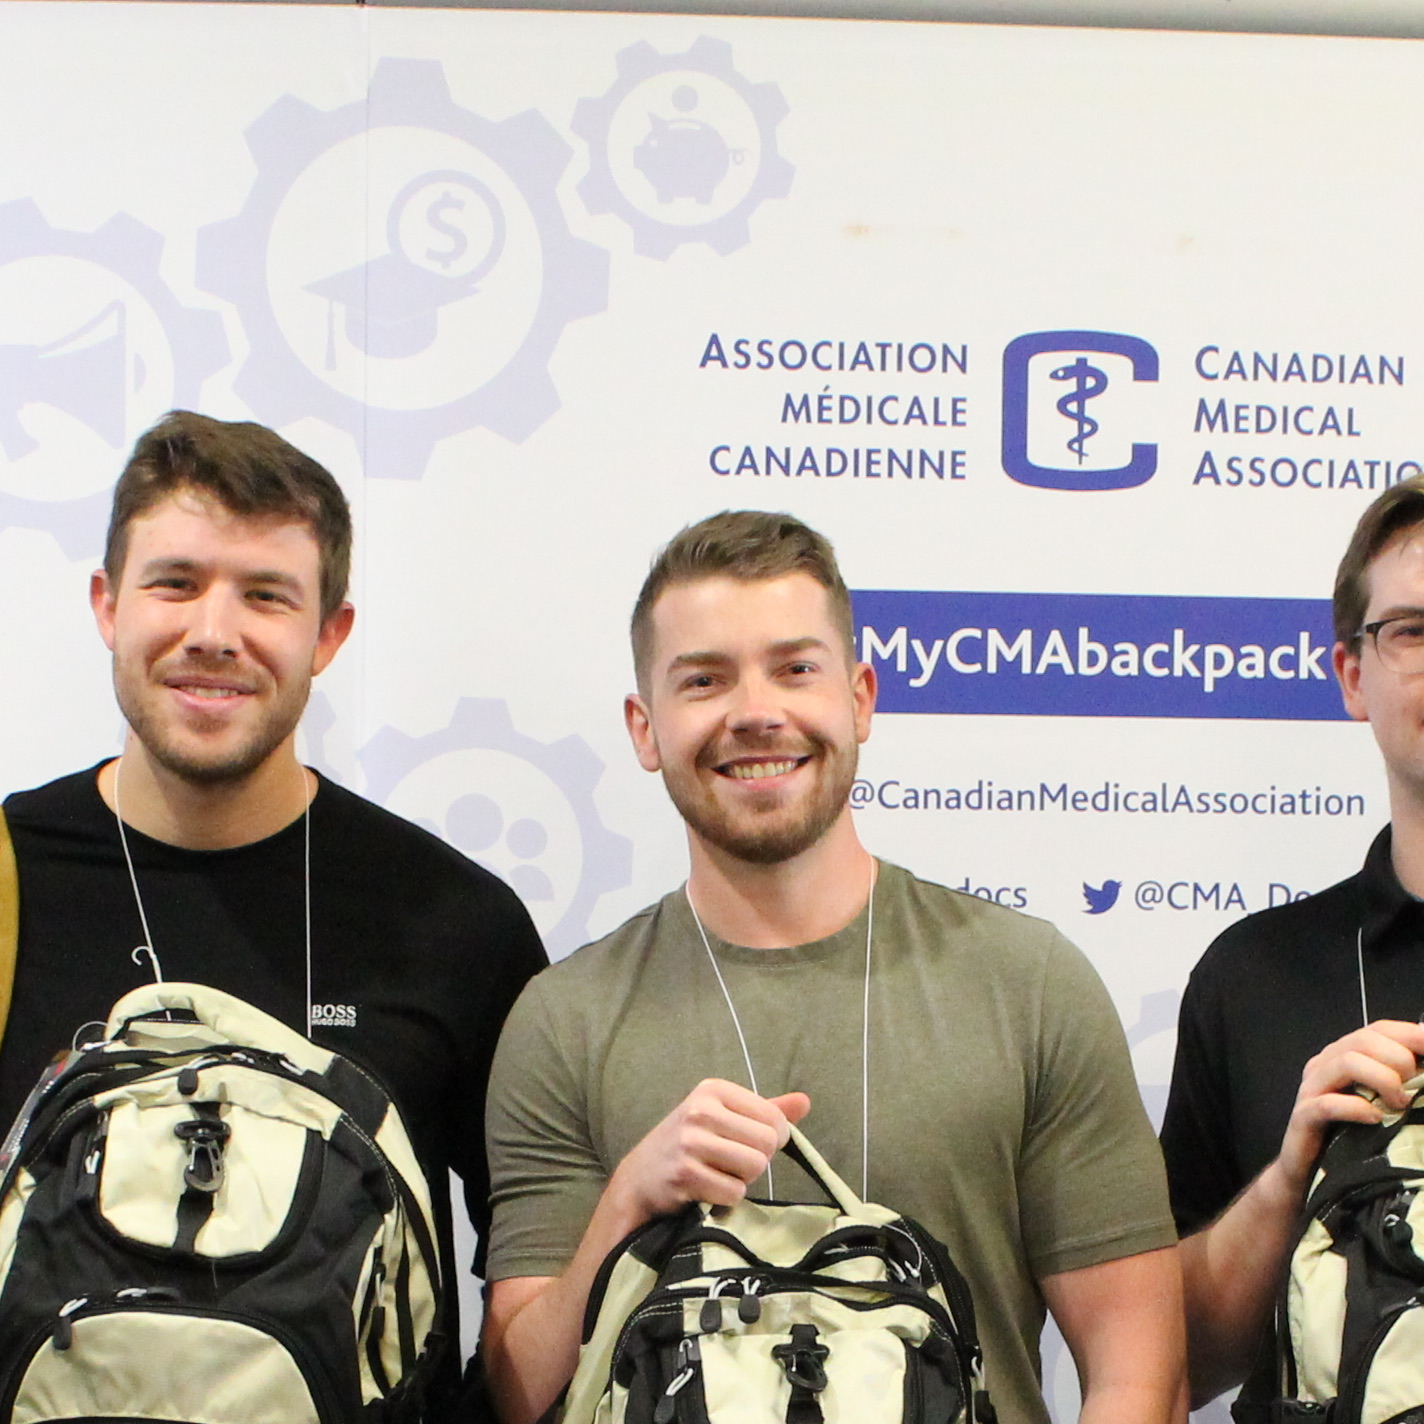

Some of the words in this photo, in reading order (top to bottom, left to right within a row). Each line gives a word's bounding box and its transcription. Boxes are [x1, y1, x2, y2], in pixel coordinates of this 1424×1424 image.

[700, 334, 967, 373] ASSOCIATION
[1196, 345, 1403, 384] CANADIAN
[782, 387, 966, 425] MÉDICALE
[1195, 398, 1360, 435] MEDICAL
[710, 445, 965, 479] CANADIENNE
[853, 626, 1326, 692] MyCMAbackpack
[849, 779, 1366, 818] @CanadianMedicalAssociation
[312, 1004, 357, 1019] BOSS
